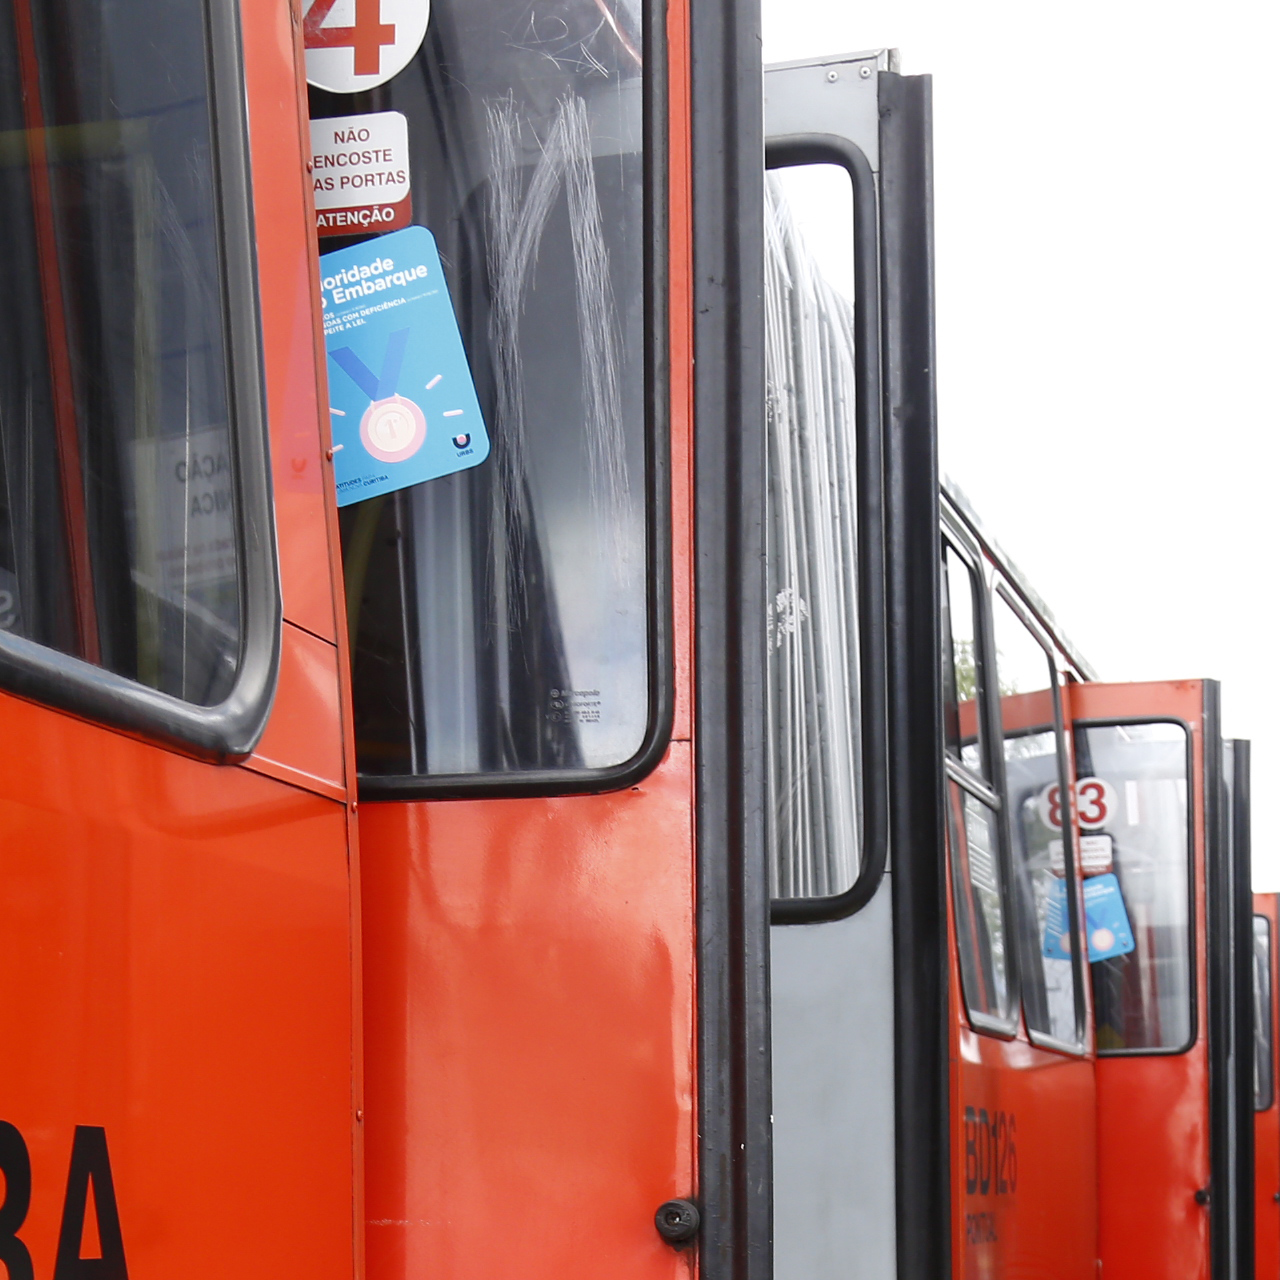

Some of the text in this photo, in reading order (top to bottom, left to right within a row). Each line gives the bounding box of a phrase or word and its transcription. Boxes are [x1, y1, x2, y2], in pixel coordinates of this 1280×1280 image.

[304, 0, 396, 76] 4
[333, 127, 371, 145] NÃO
[313, 148, 394, 169] ENCOSTE
[340, 170, 407, 190] PORTAS
[316, 206, 395, 227] ATENÇÃO
[332, 264, 428, 305] Embarque
